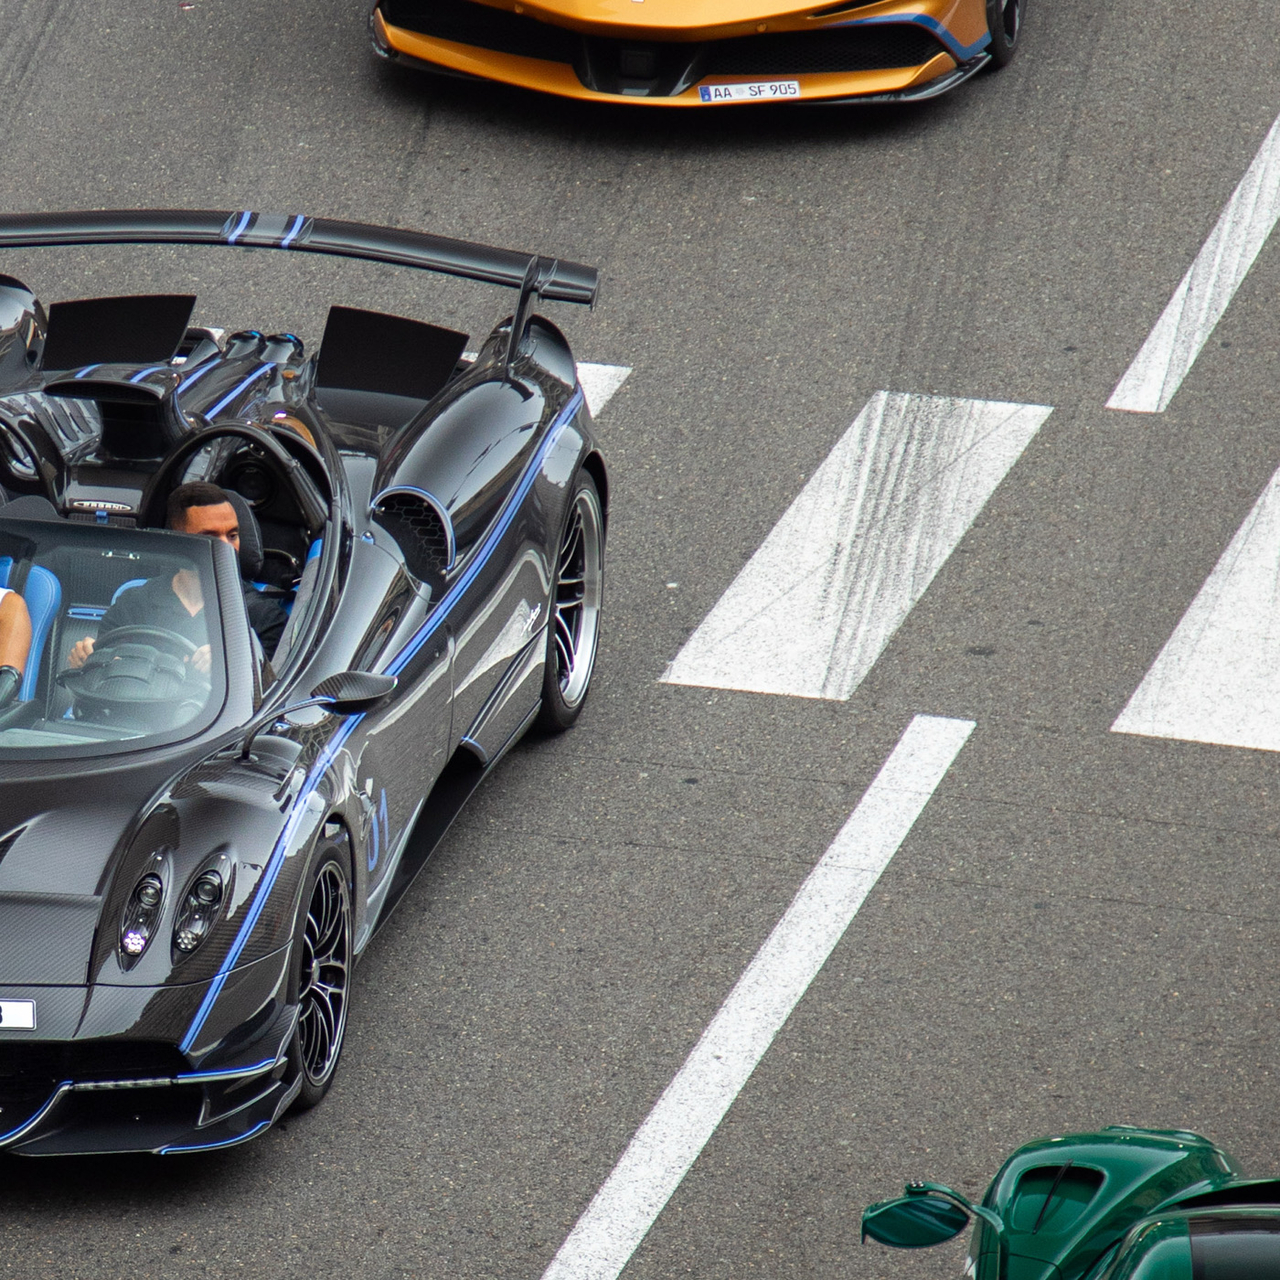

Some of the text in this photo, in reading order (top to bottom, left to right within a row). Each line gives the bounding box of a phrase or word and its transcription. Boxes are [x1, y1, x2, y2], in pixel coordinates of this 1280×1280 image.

[713, 83, 797, 99] AA SF 905
